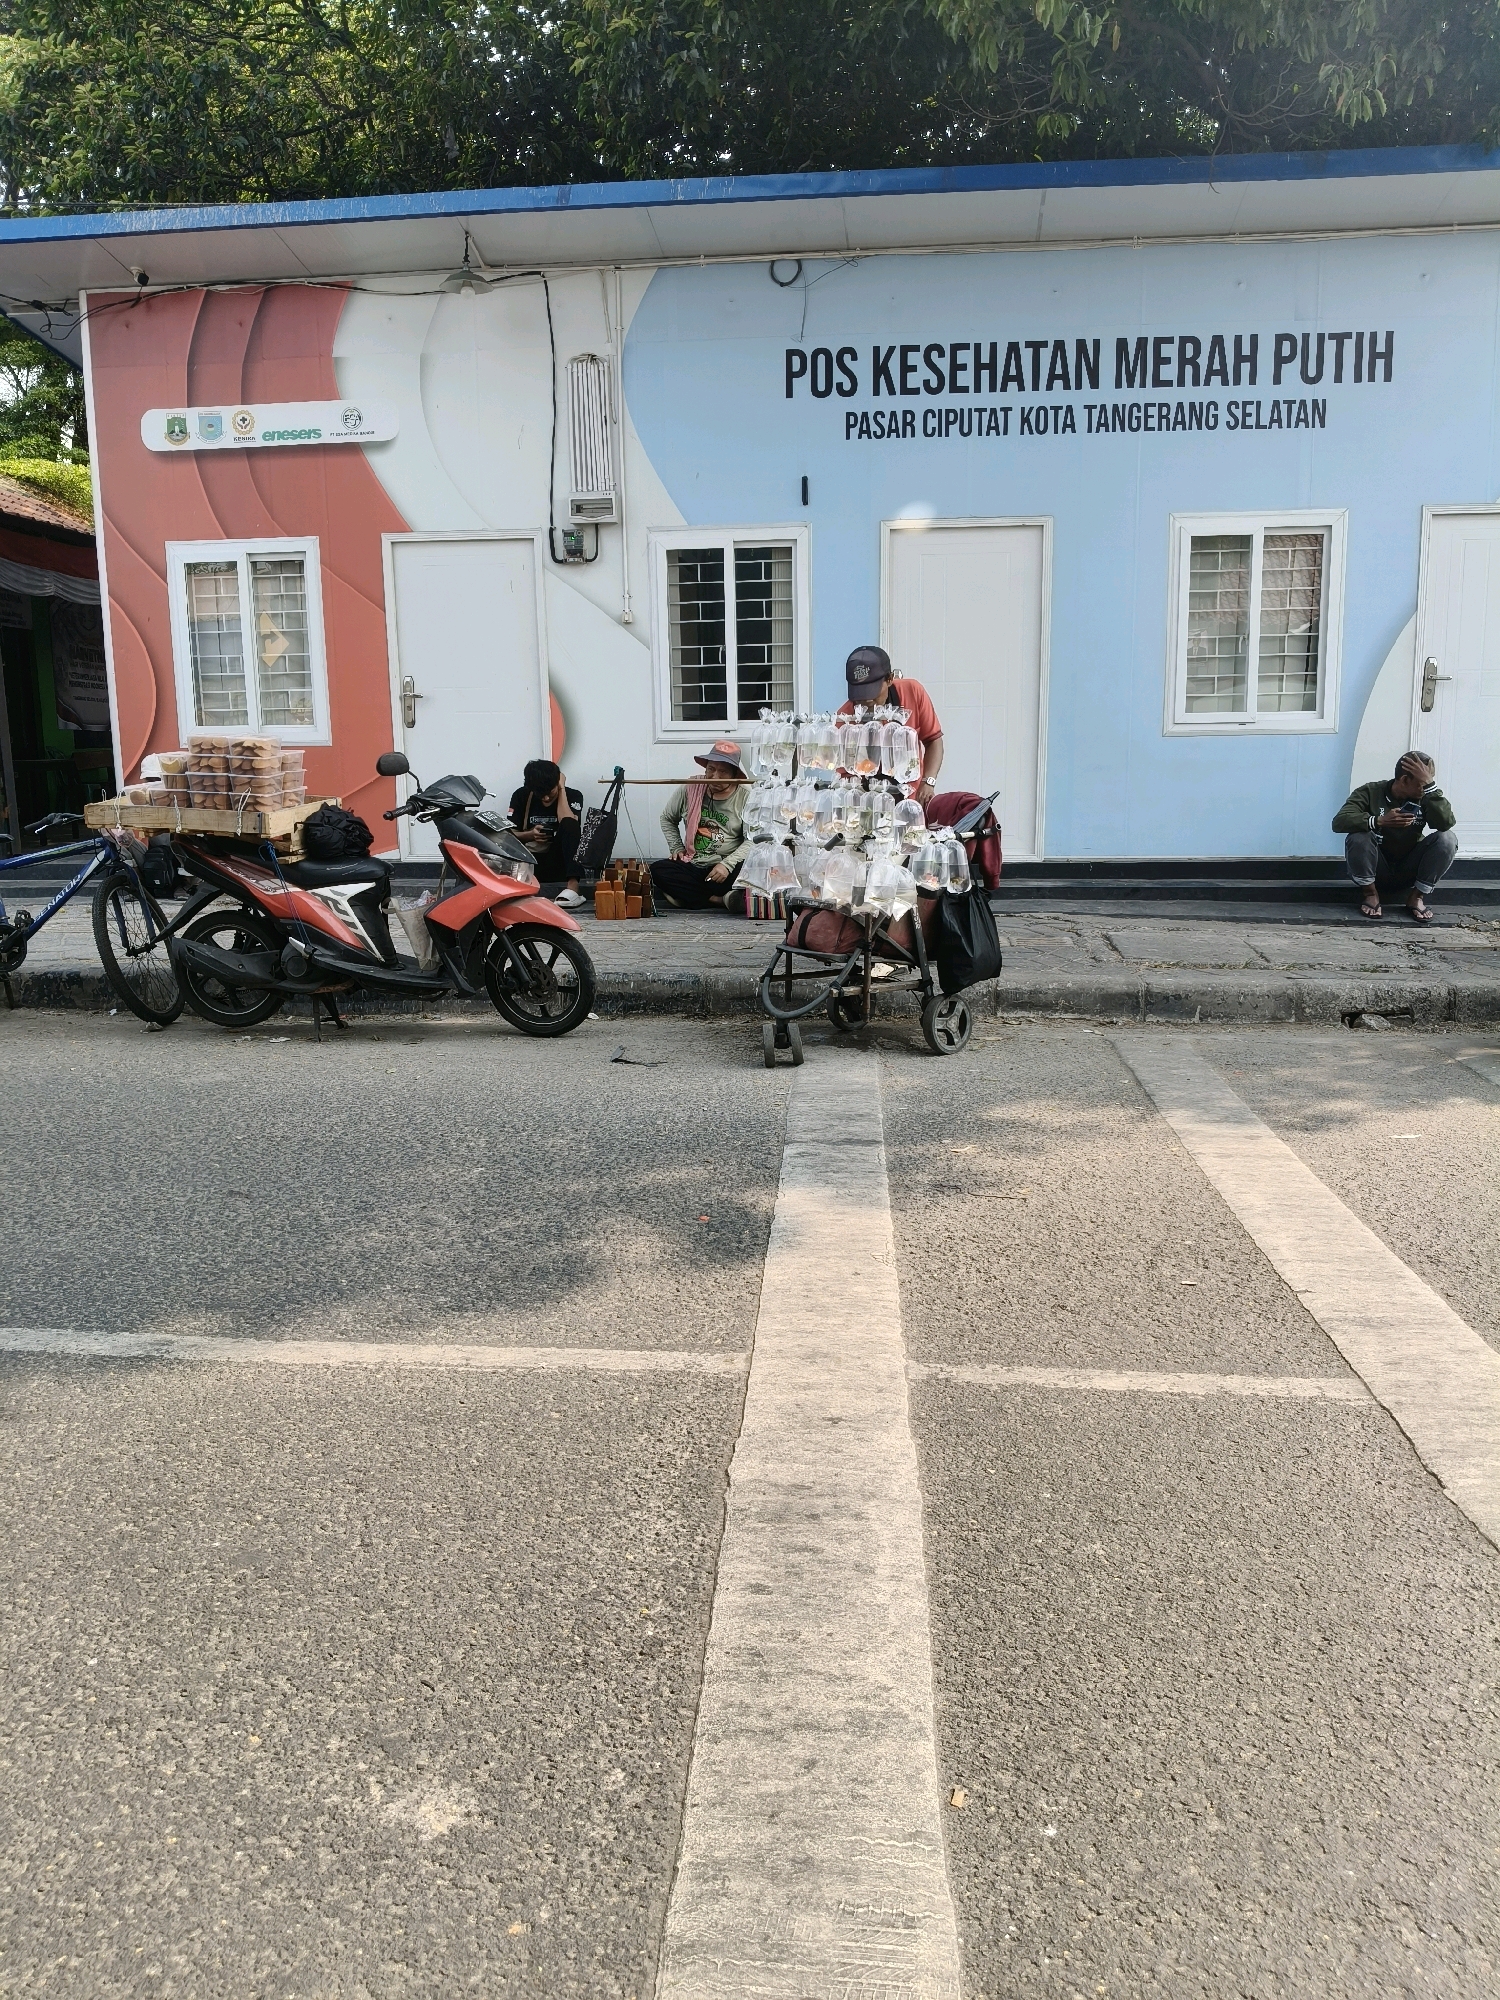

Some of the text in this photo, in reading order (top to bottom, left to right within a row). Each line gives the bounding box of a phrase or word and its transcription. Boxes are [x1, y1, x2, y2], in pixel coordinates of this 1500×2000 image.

[785, 330, 1395, 399] POS KESEHATAN MERAH PUTIH
[261, 428, 323, 442] enesers
[845, 398, 1327, 441] PASAR CIPUTAT KOTA TANGERANG SELATAN
[32, 873, 82, 924] SENATOR
